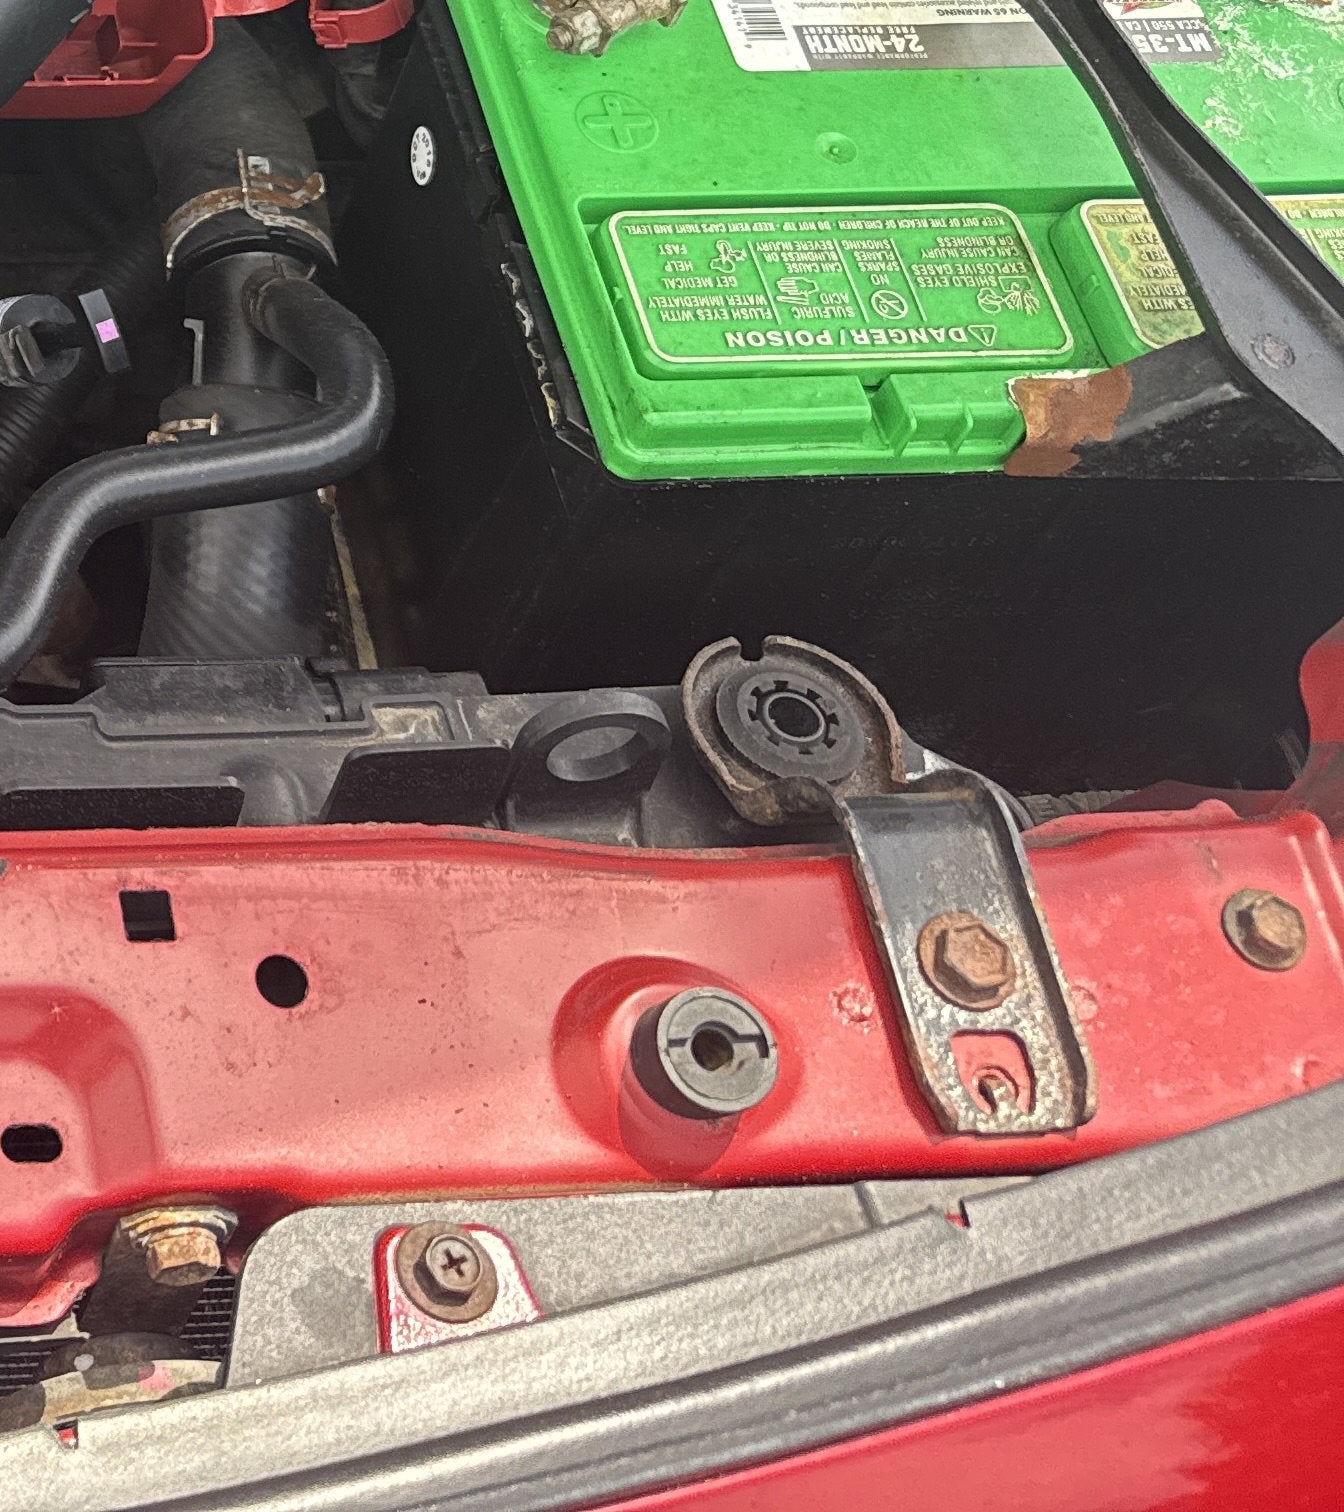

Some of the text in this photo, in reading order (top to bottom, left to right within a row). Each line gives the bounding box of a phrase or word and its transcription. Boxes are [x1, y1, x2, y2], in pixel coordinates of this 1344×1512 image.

[936, 8, 991, 16] WARNING
[1153, 20, 1172, 31] 550
[804, 34, 925, 53] 24-MONTH
[1131, 33, 1213, 53] MT-35
[898, 218, 926, 228] REACH
[928, 218, 946, 227] THE
[948, 217, 960, 227] OF
[962, 217, 979, 227] OUT
[981, 216, 1005, 226] KEEP
[1125, 212, 1144, 223] AND
[653, 224, 673, 234] AND
[675, 223, 699, 233] TIGHT
[701, 223, 726, 233] CAPS
[752, 222, 775, 232] KEEP
[783, 222, 795, 232] TIP
[797, 221, 818, 231] NOT
[819, 220, 832, 231] DO
[839, 220, 883, 230] CHILDREN
[884, 219, 895, 229] OF
[936, 235, 1013, 248] OR BLINDNESS
[1132, 232, 1159, 244] FAST
[658, 243, 688, 255] FAST
[754, 240, 833, 252] SEVERE INJURY
[841, 239, 890, 250] SMOKING
[762, 250, 839, 262] BLINDNESS OR
[854, 250, 894, 261] FLAMES
[921, 246, 1018, 259] CAN CAUSE INJURY
[1141, 250, 1169, 261] HELP
[664, 260, 694, 272] HELP
[785, 262, 842, 273] CAN CAUSE
[858, 261, 899, 272] SPARKS
[911, 262, 1026, 276] EXPLOSIVE GASES
[660, 275, 738, 289] GET MEDICAL
[870, 273, 890, 286] NO
[917, 275, 998, 288] SHIELD EYES
[647, 293, 767, 308] WATER IMMEDIATELY
[820, 293, 850, 305] ACID
[1142, 298, 1174, 310] WITH
[660, 307, 772, 322] FLUSH EYES WITH
[790, 306, 855, 319] SULFURIC
[724, 330, 833, 348] POISON
[850, 327, 968, 344] DANGER
